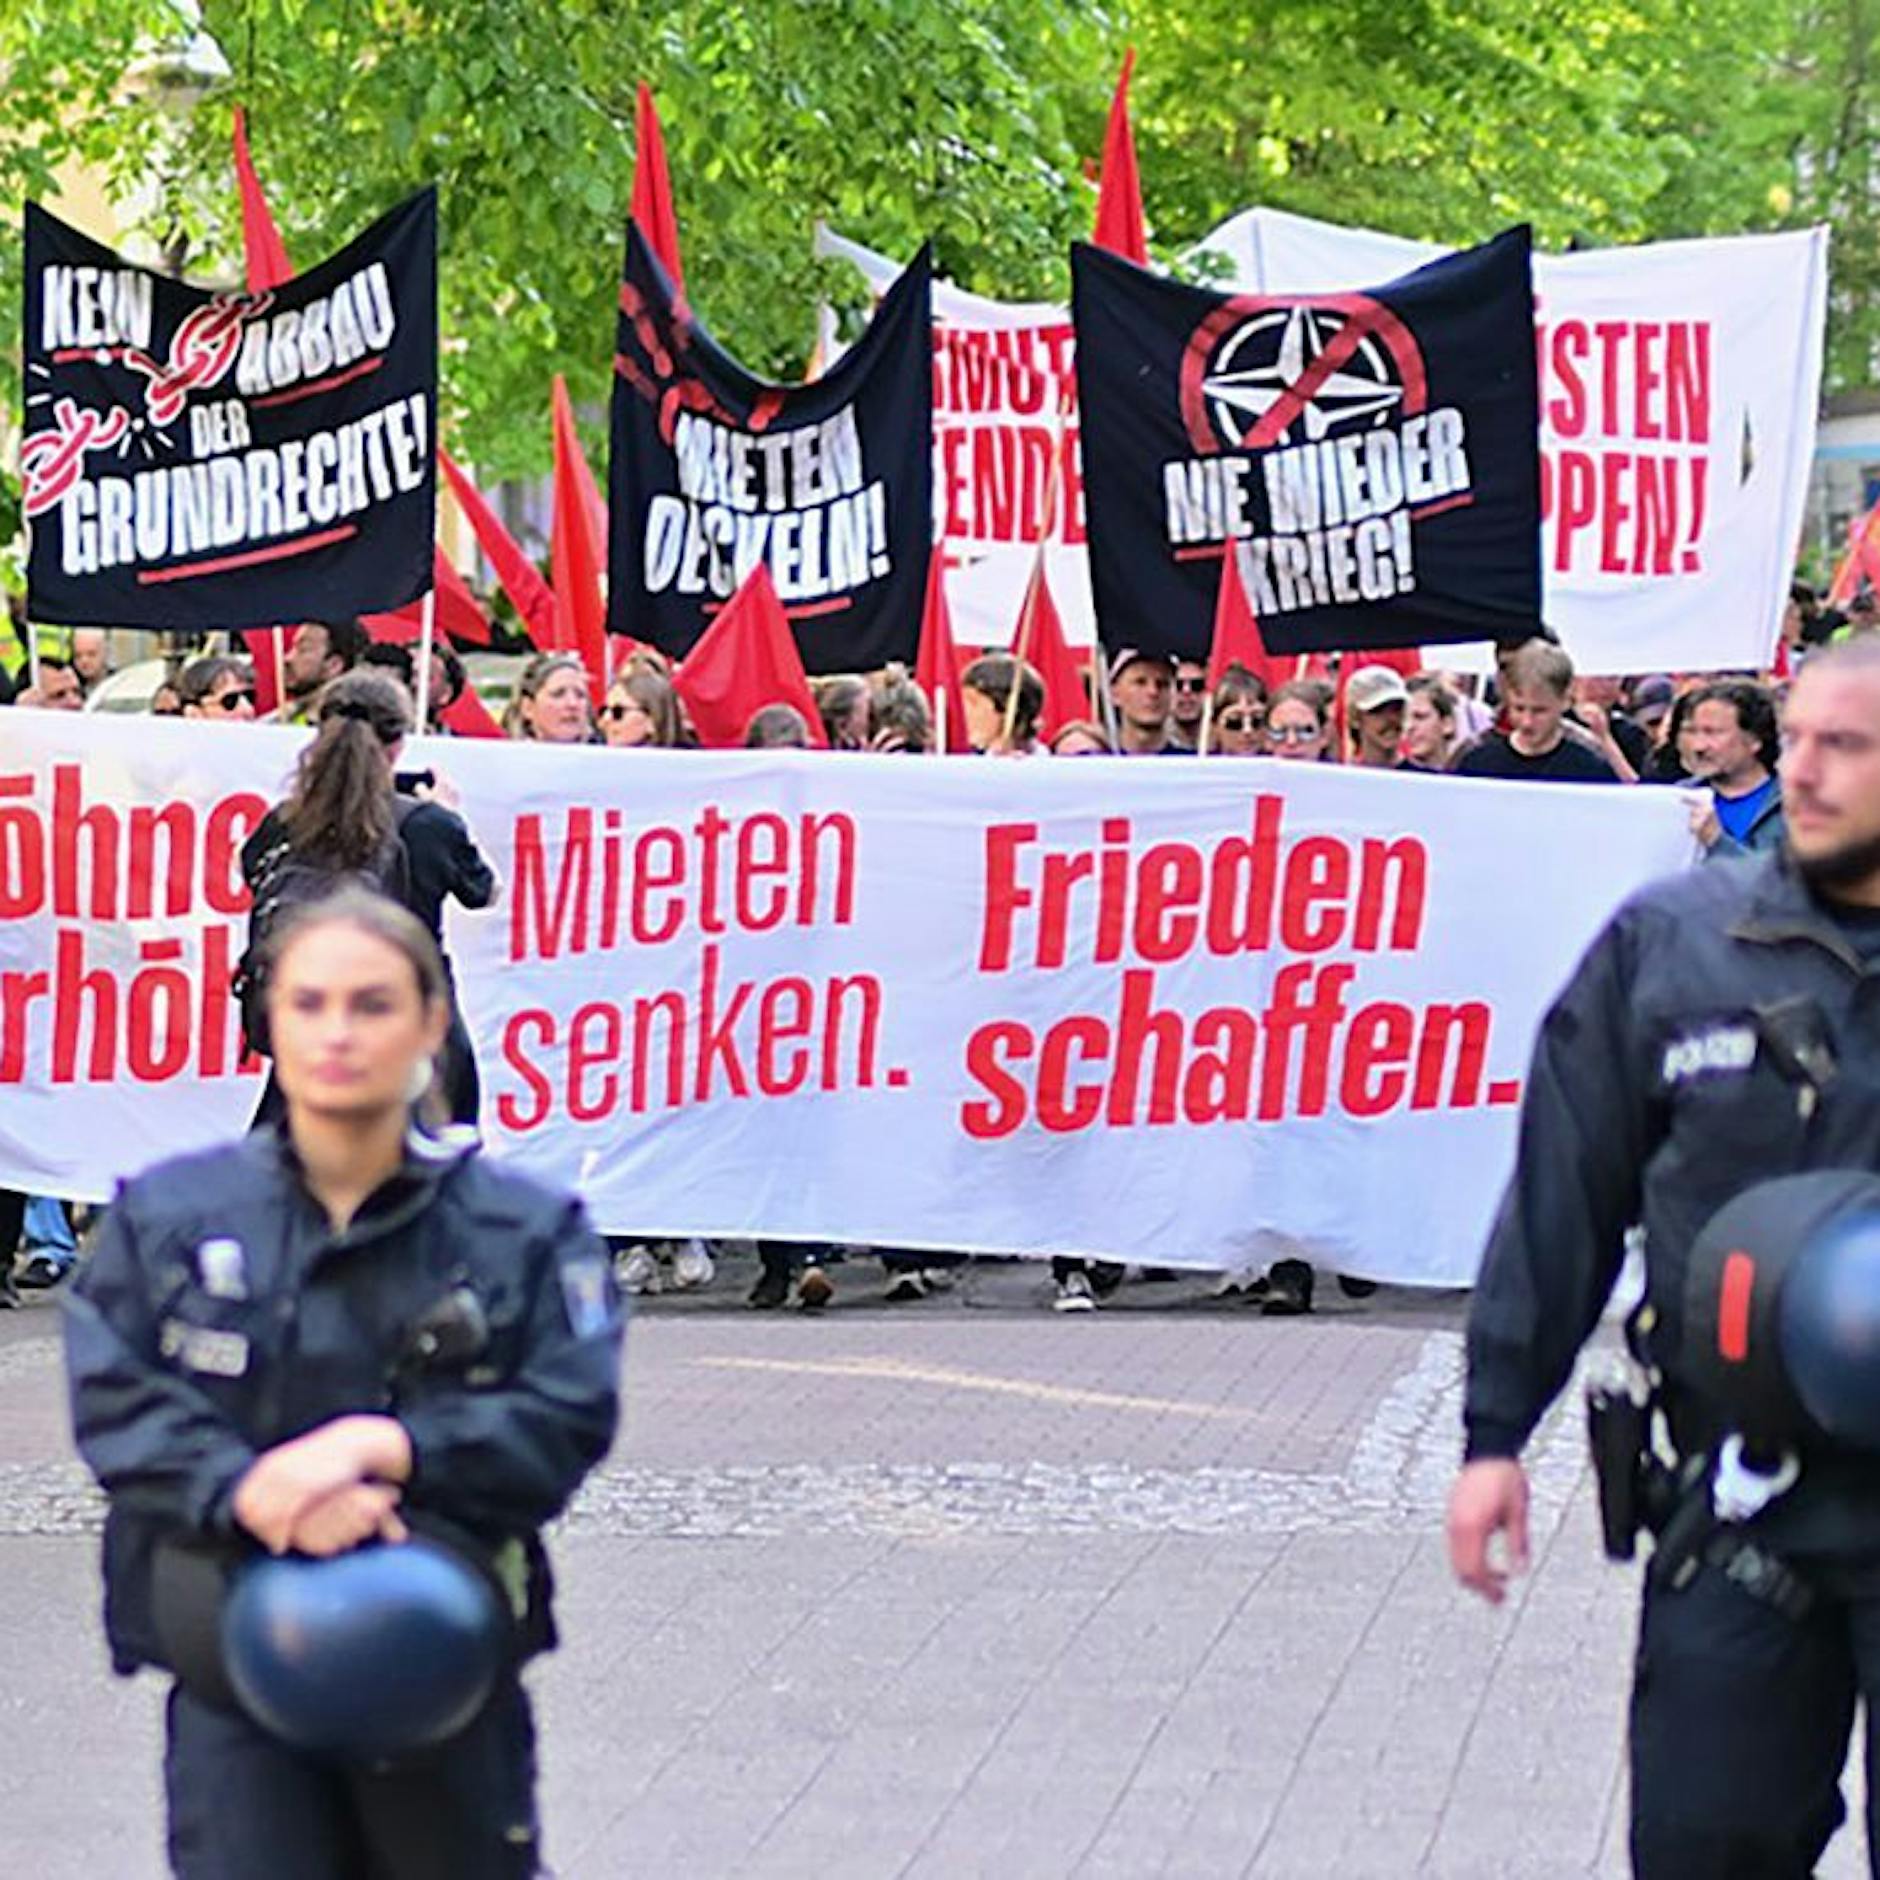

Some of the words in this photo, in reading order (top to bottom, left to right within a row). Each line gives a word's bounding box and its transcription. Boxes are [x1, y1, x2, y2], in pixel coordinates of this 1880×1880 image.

[43, 264, 153, 351] KEIN
[236, 261, 397, 396] ABBAU
[1535, 318, 1710, 444] STEN
[62, 393, 428, 575] GRUNDRECHTE!
[189, 398, 251, 458] DER
[675, 402, 863, 512] MIETEN
[931, 425, 1089, 545] ENDE
[1163, 456, 1254, 544] NIE
[1262, 407, 1471, 535] WIEDER
[643, 479, 893, 600] DECKELN!
[1236, 509, 1416, 617] KRIEG!
[510, 806, 857, 963] Mieten
[978, 794, 1427, 973] Frieden
[497, 944, 910, 1132] senken.
[960, 961, 1521, 1140] schaffen.
